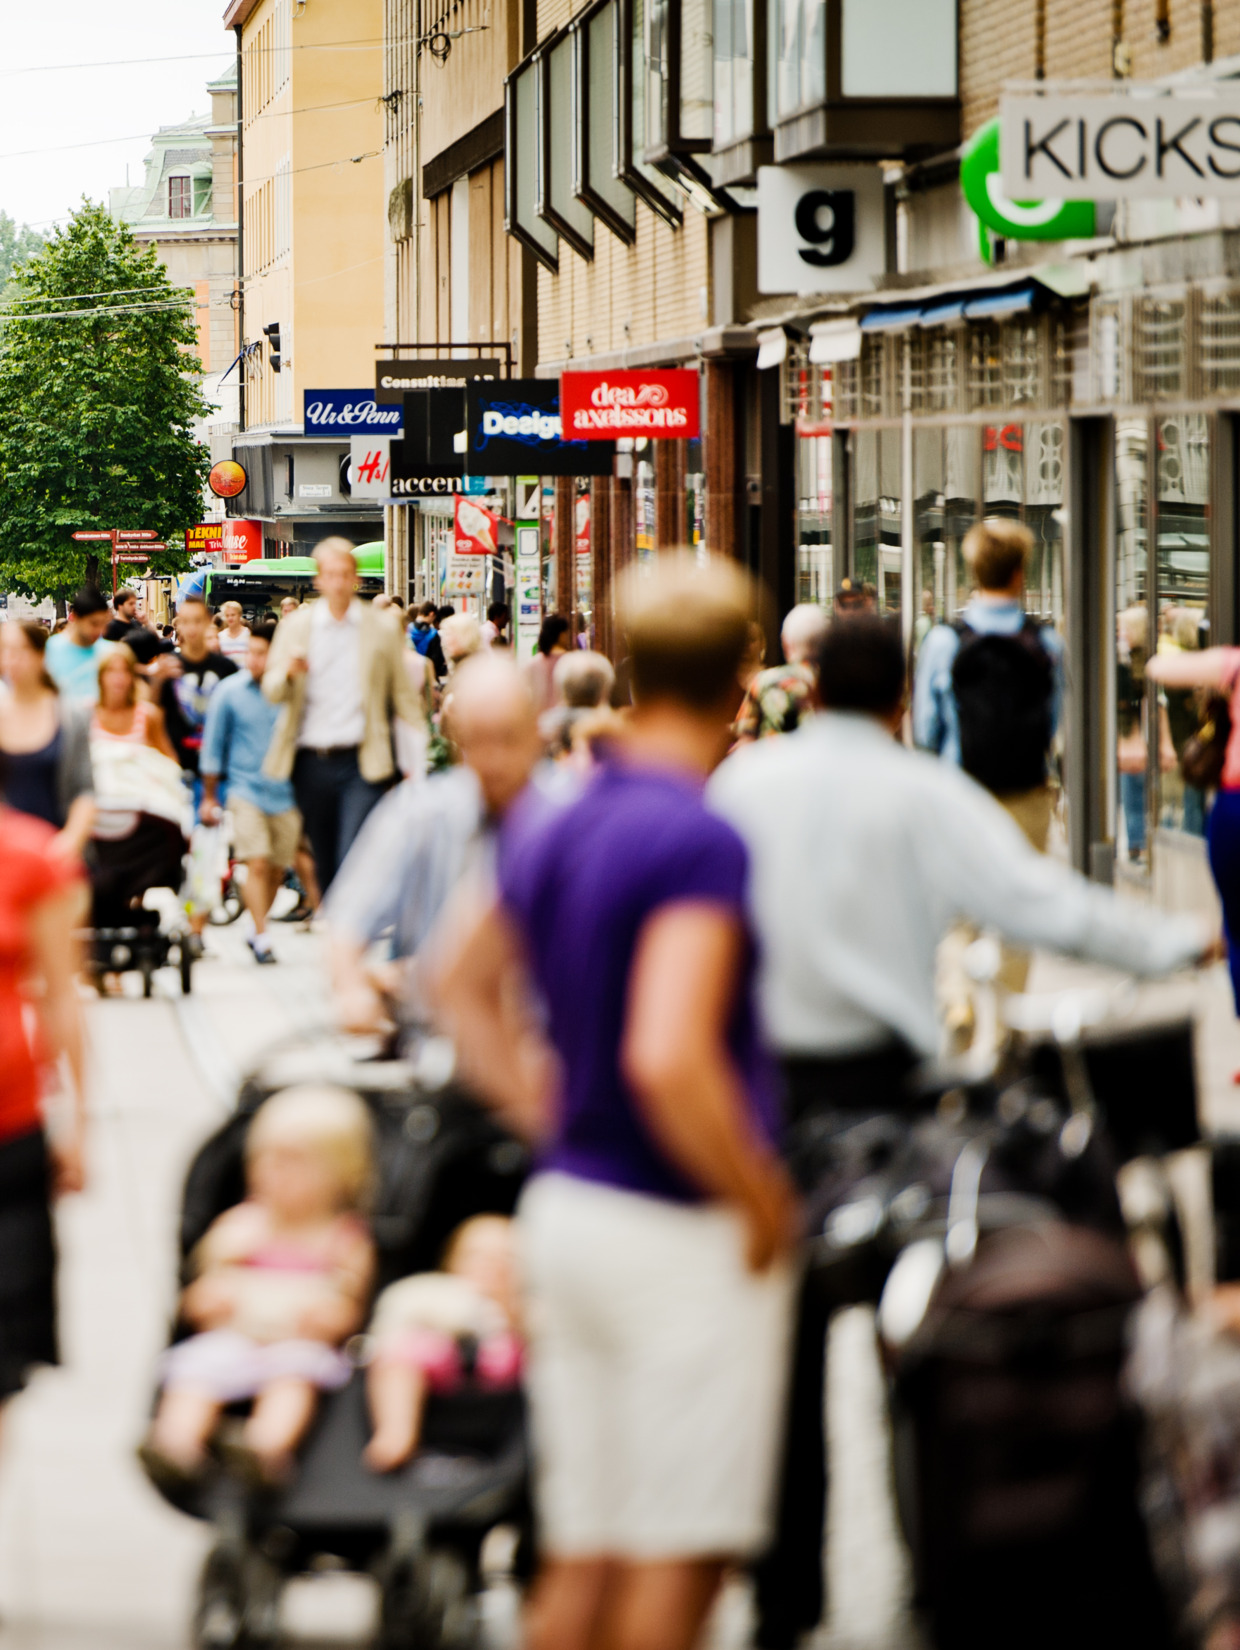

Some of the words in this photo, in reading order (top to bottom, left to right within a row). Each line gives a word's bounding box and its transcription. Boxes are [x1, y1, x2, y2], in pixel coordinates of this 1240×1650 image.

[1024, 116, 1240, 179] KICKS
[591, 382, 636, 406] dea
[573, 404, 688, 429] axelssons
[392, 475, 471, 494] accent
